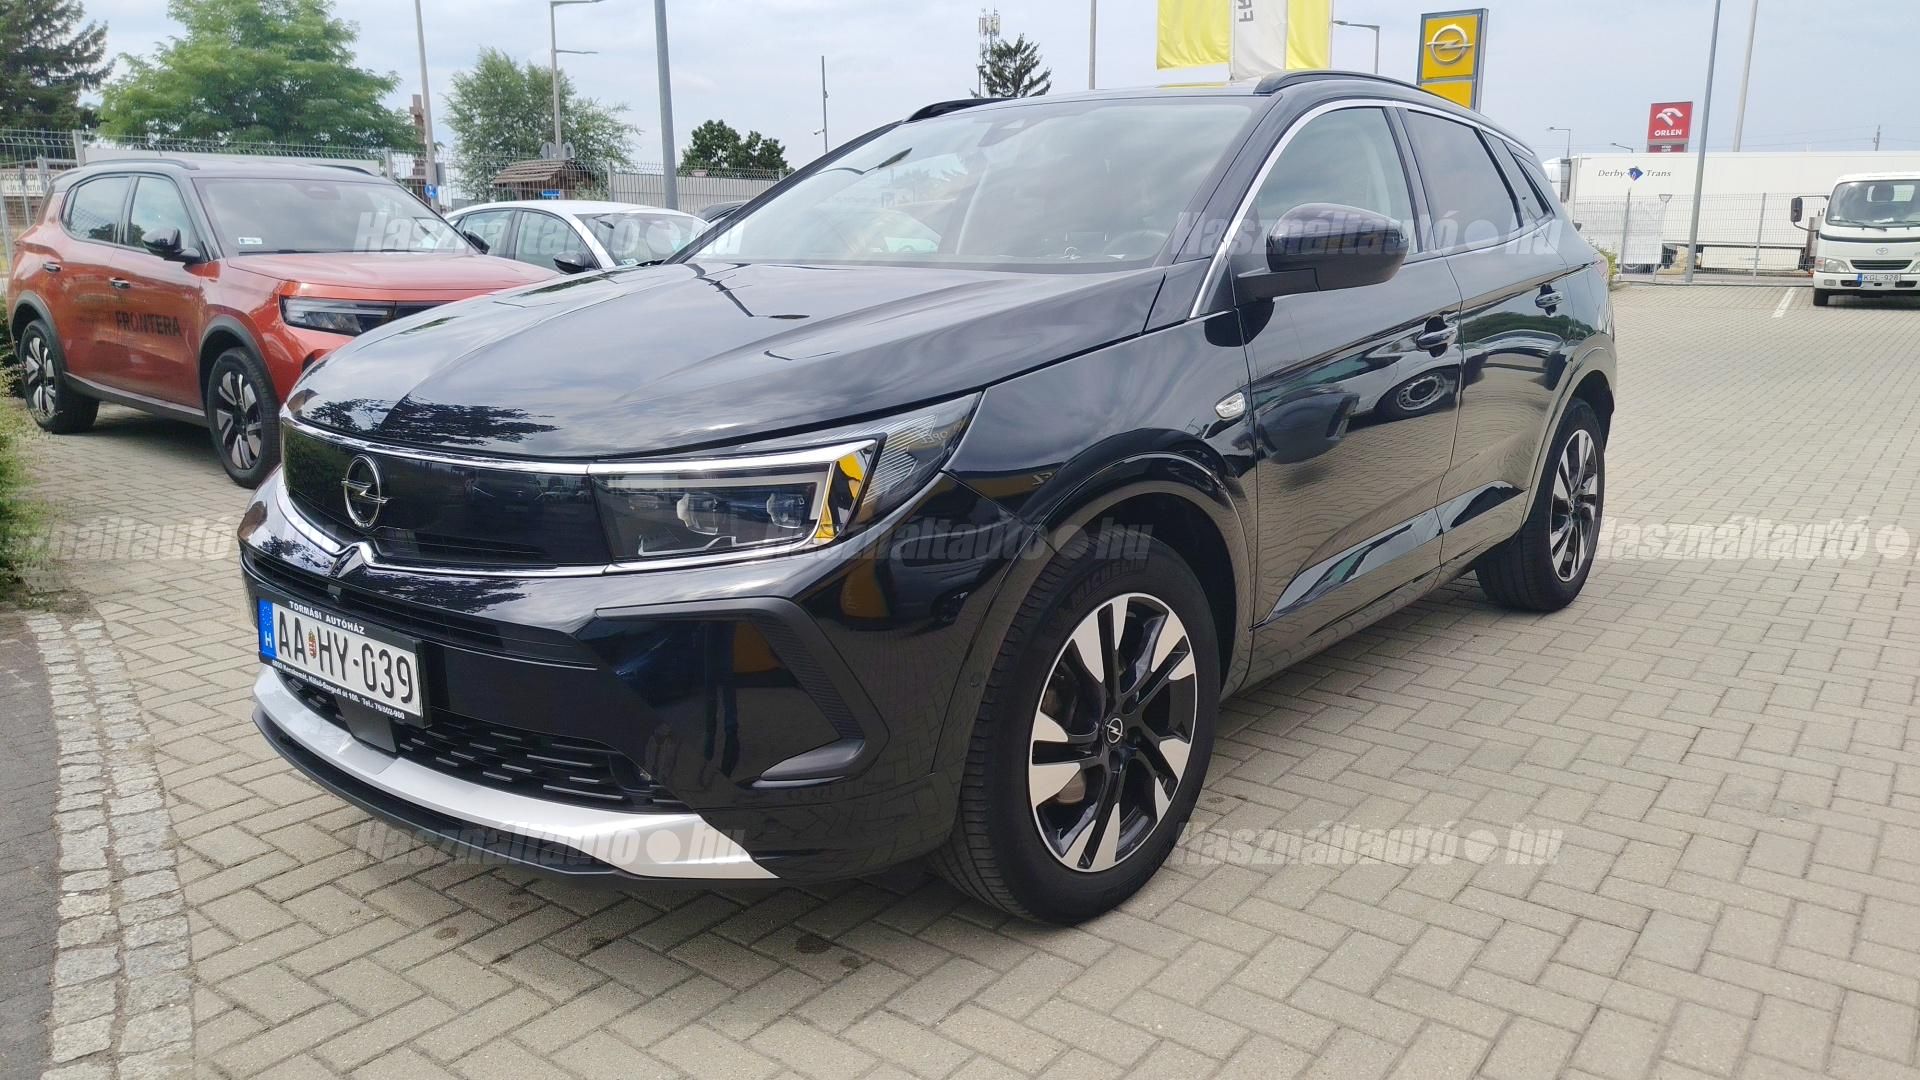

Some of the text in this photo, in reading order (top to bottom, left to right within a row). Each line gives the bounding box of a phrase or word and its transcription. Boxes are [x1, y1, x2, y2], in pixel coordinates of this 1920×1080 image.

[1654, 128, 1683, 137] ORLEN
[1597, 168, 1672, 178] Derby Trans
[115, 311, 181, 337] FRONTERA
[289, 601, 366, 635] TORMÁSI AUTÓHÁZ
[265, 631, 272, 648] H
